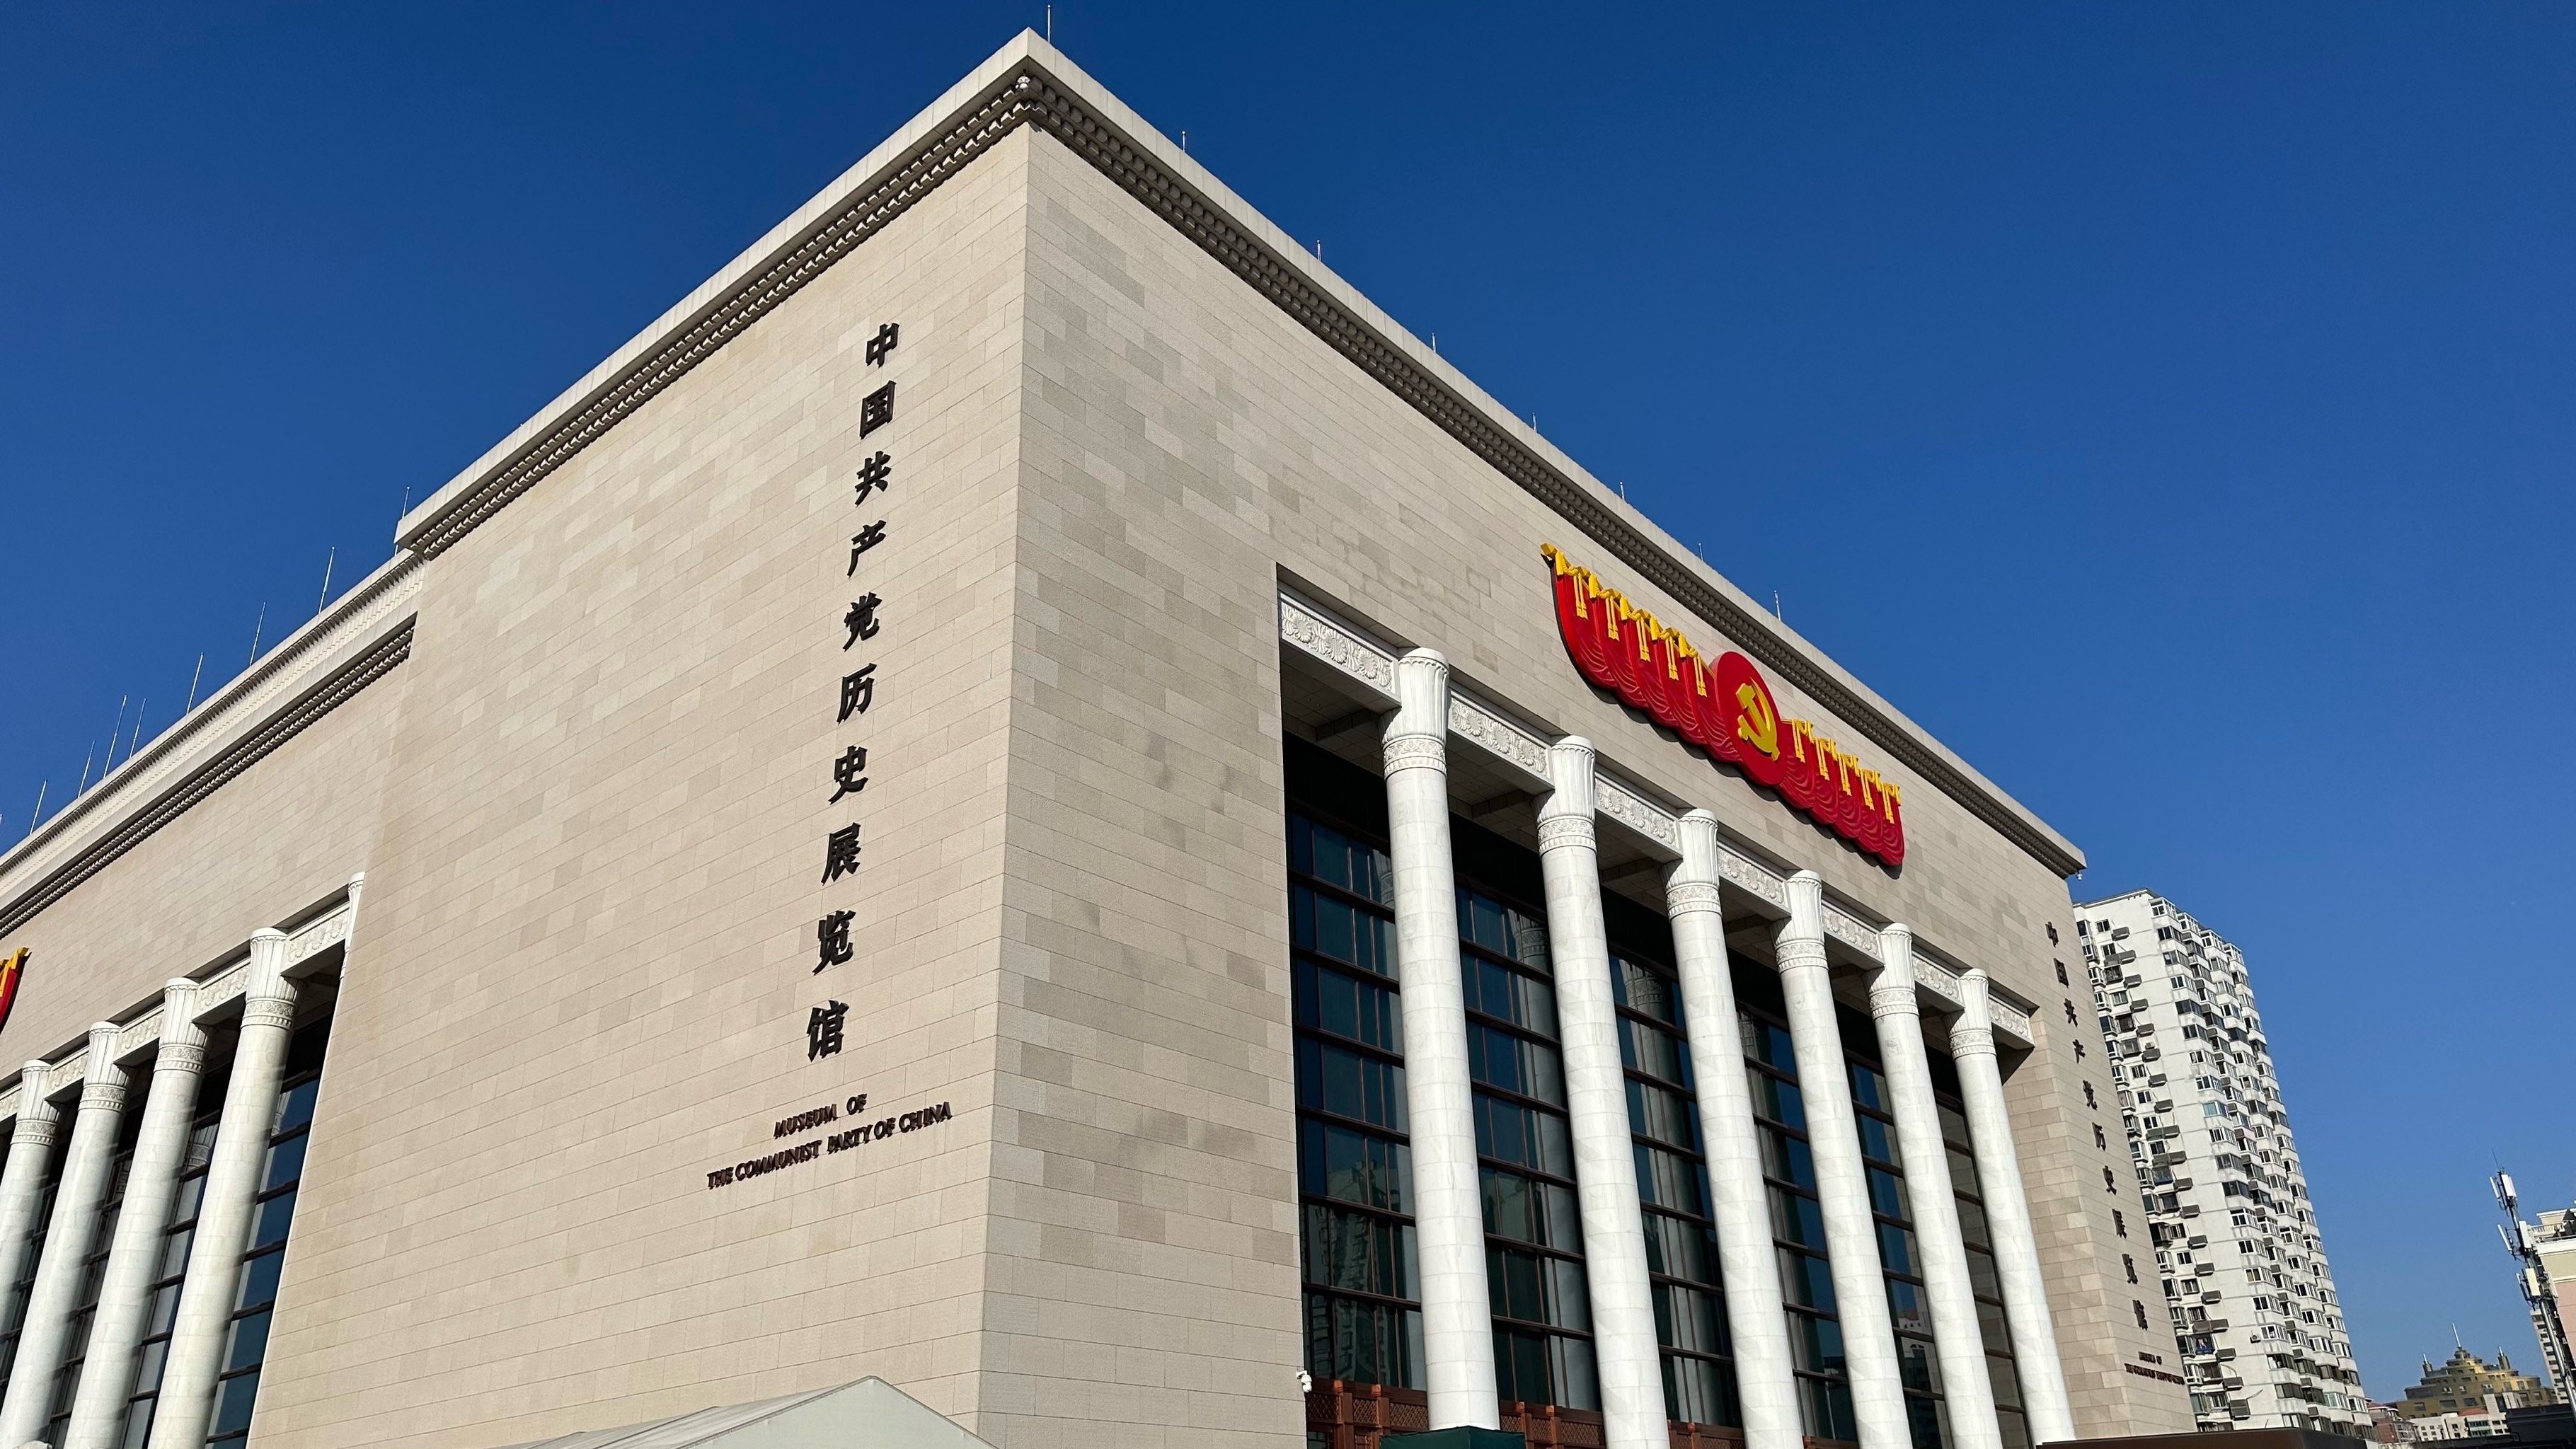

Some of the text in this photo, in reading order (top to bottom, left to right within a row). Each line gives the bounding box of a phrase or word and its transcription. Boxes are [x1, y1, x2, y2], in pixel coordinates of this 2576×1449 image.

[806, 322, 901, 1063] 中国共产党历史展览馆
[706, 1101, 953, 1190] THE COMMUNIST PARTY OF CHINA
[773, 1093, 868, 1140] MUSEUM OF
